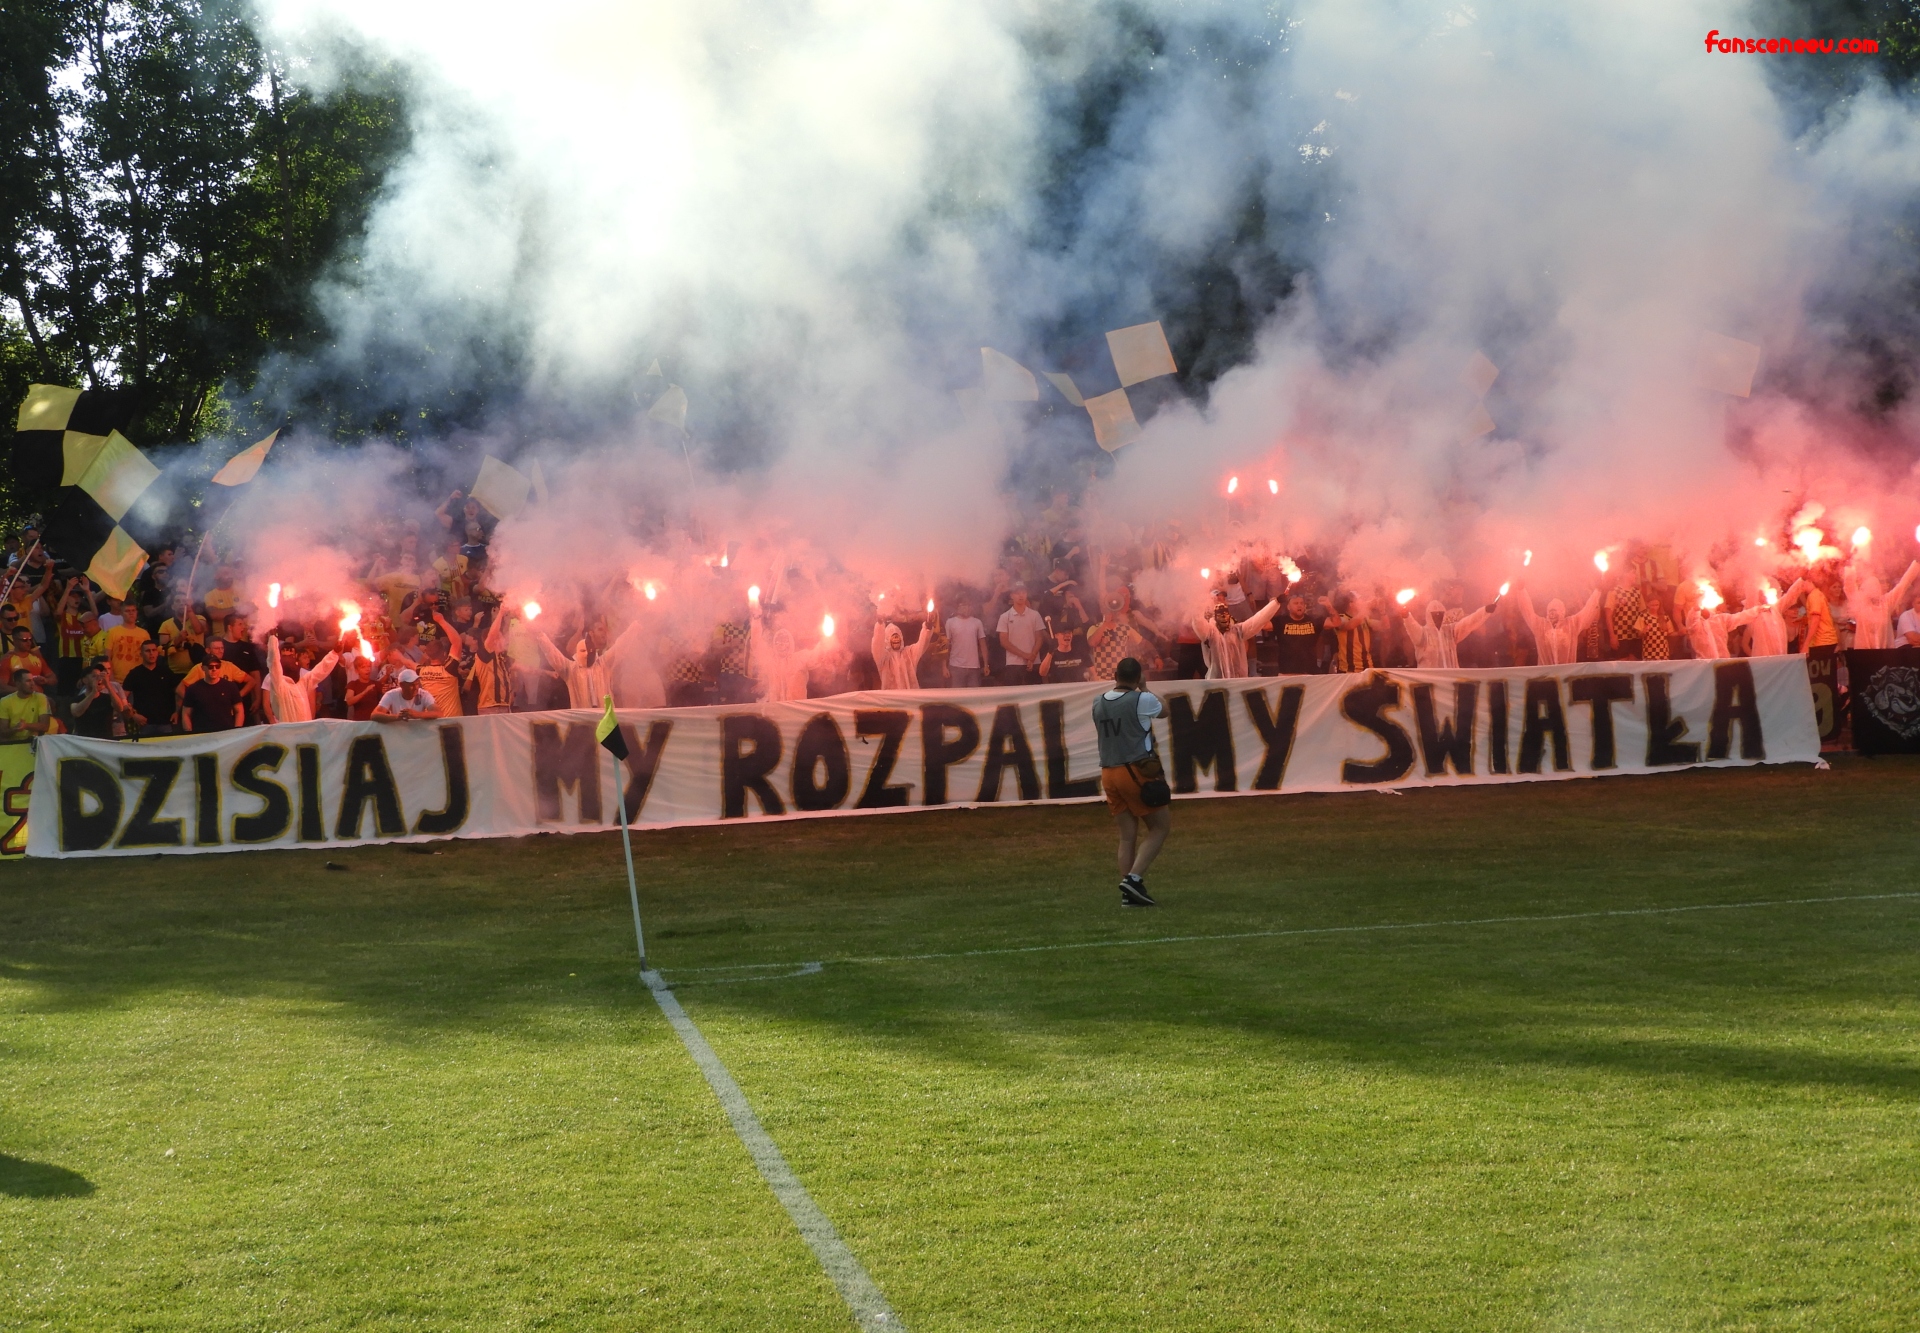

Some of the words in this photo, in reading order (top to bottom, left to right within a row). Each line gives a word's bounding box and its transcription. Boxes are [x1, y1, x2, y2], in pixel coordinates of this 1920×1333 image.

[57, 723, 471, 852] DZISIAJ
[529, 719, 674, 826] MY
[718, 684, 1305, 819] ROZPALMY
[1100, 718, 1121, 738] TV
